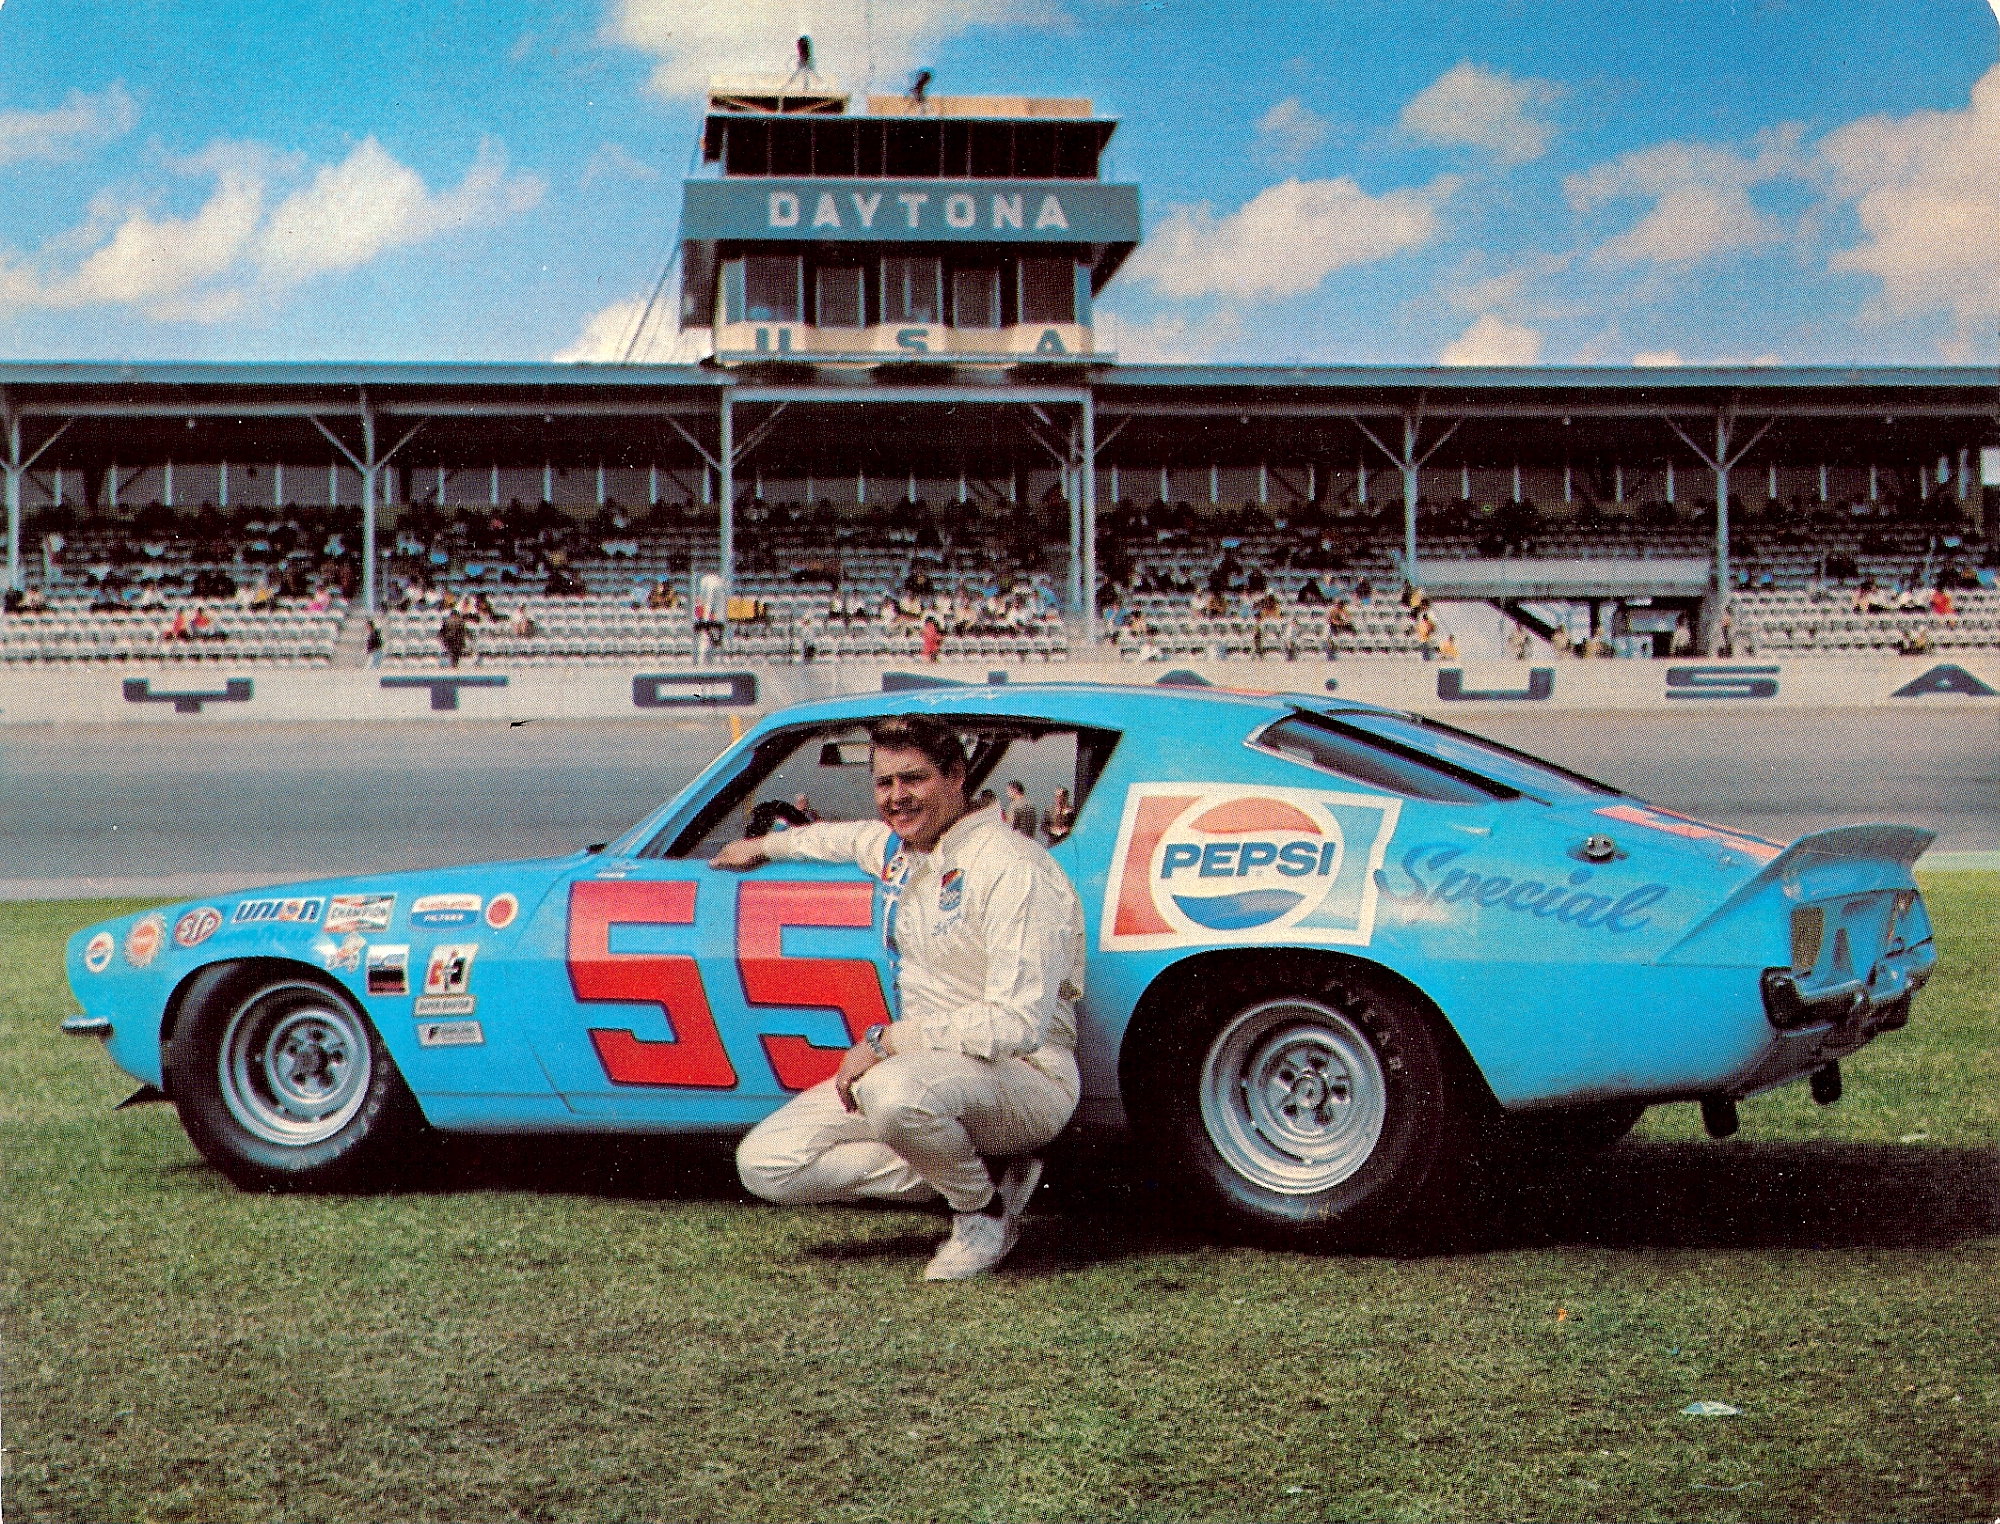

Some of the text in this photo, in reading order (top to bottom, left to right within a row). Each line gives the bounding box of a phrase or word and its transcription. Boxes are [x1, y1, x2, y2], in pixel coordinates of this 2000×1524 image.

[768, 191, 1069, 229] DAYTONA
[1159, 840, 1337, 880] PEPSI
[1373, 841, 1670, 935] Special
[179, 911, 217, 941] STP
